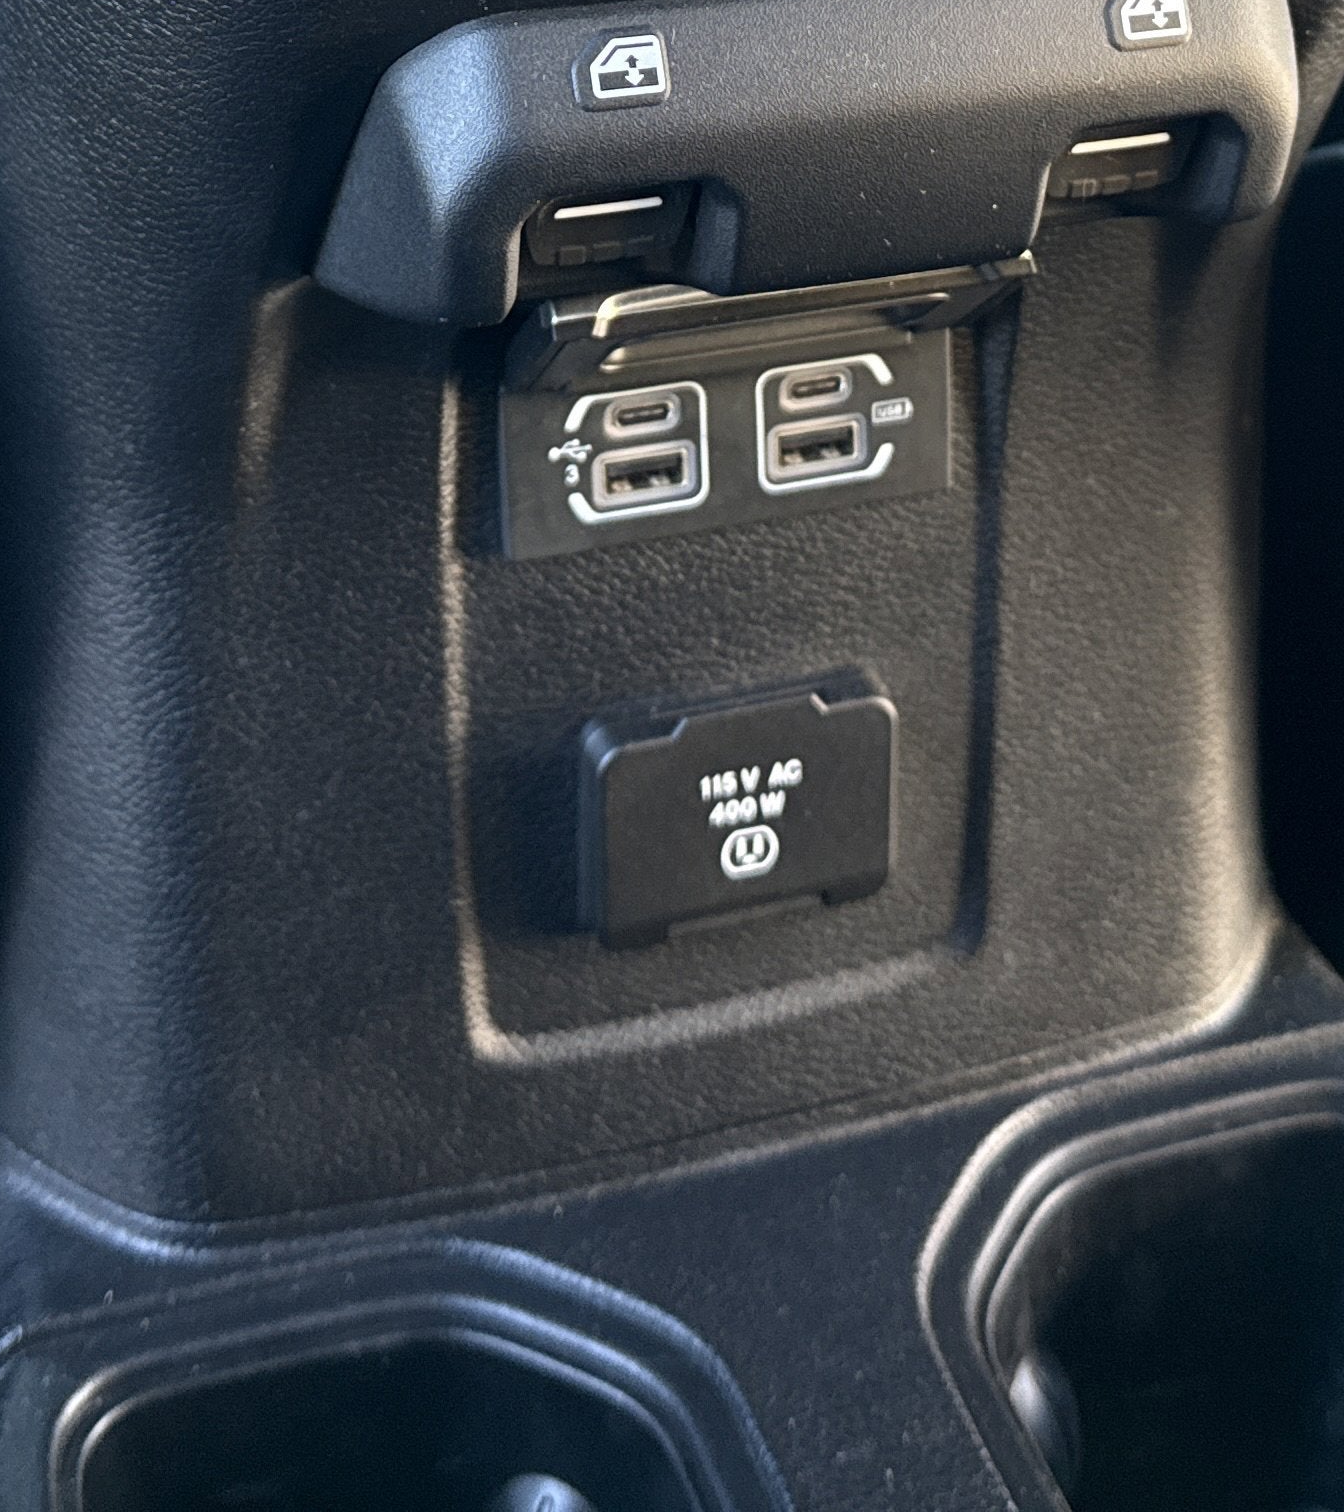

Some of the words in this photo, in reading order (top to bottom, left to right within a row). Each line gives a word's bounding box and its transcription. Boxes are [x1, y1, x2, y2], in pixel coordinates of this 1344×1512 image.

[564, 463, 579, 486] 3
[700, 770, 738, 802] 115
[740, 765, 761, 793] V
[768, 758, 803, 789] AC
[708, 795, 758, 827] 400
[759, 789, 787, 819] W
